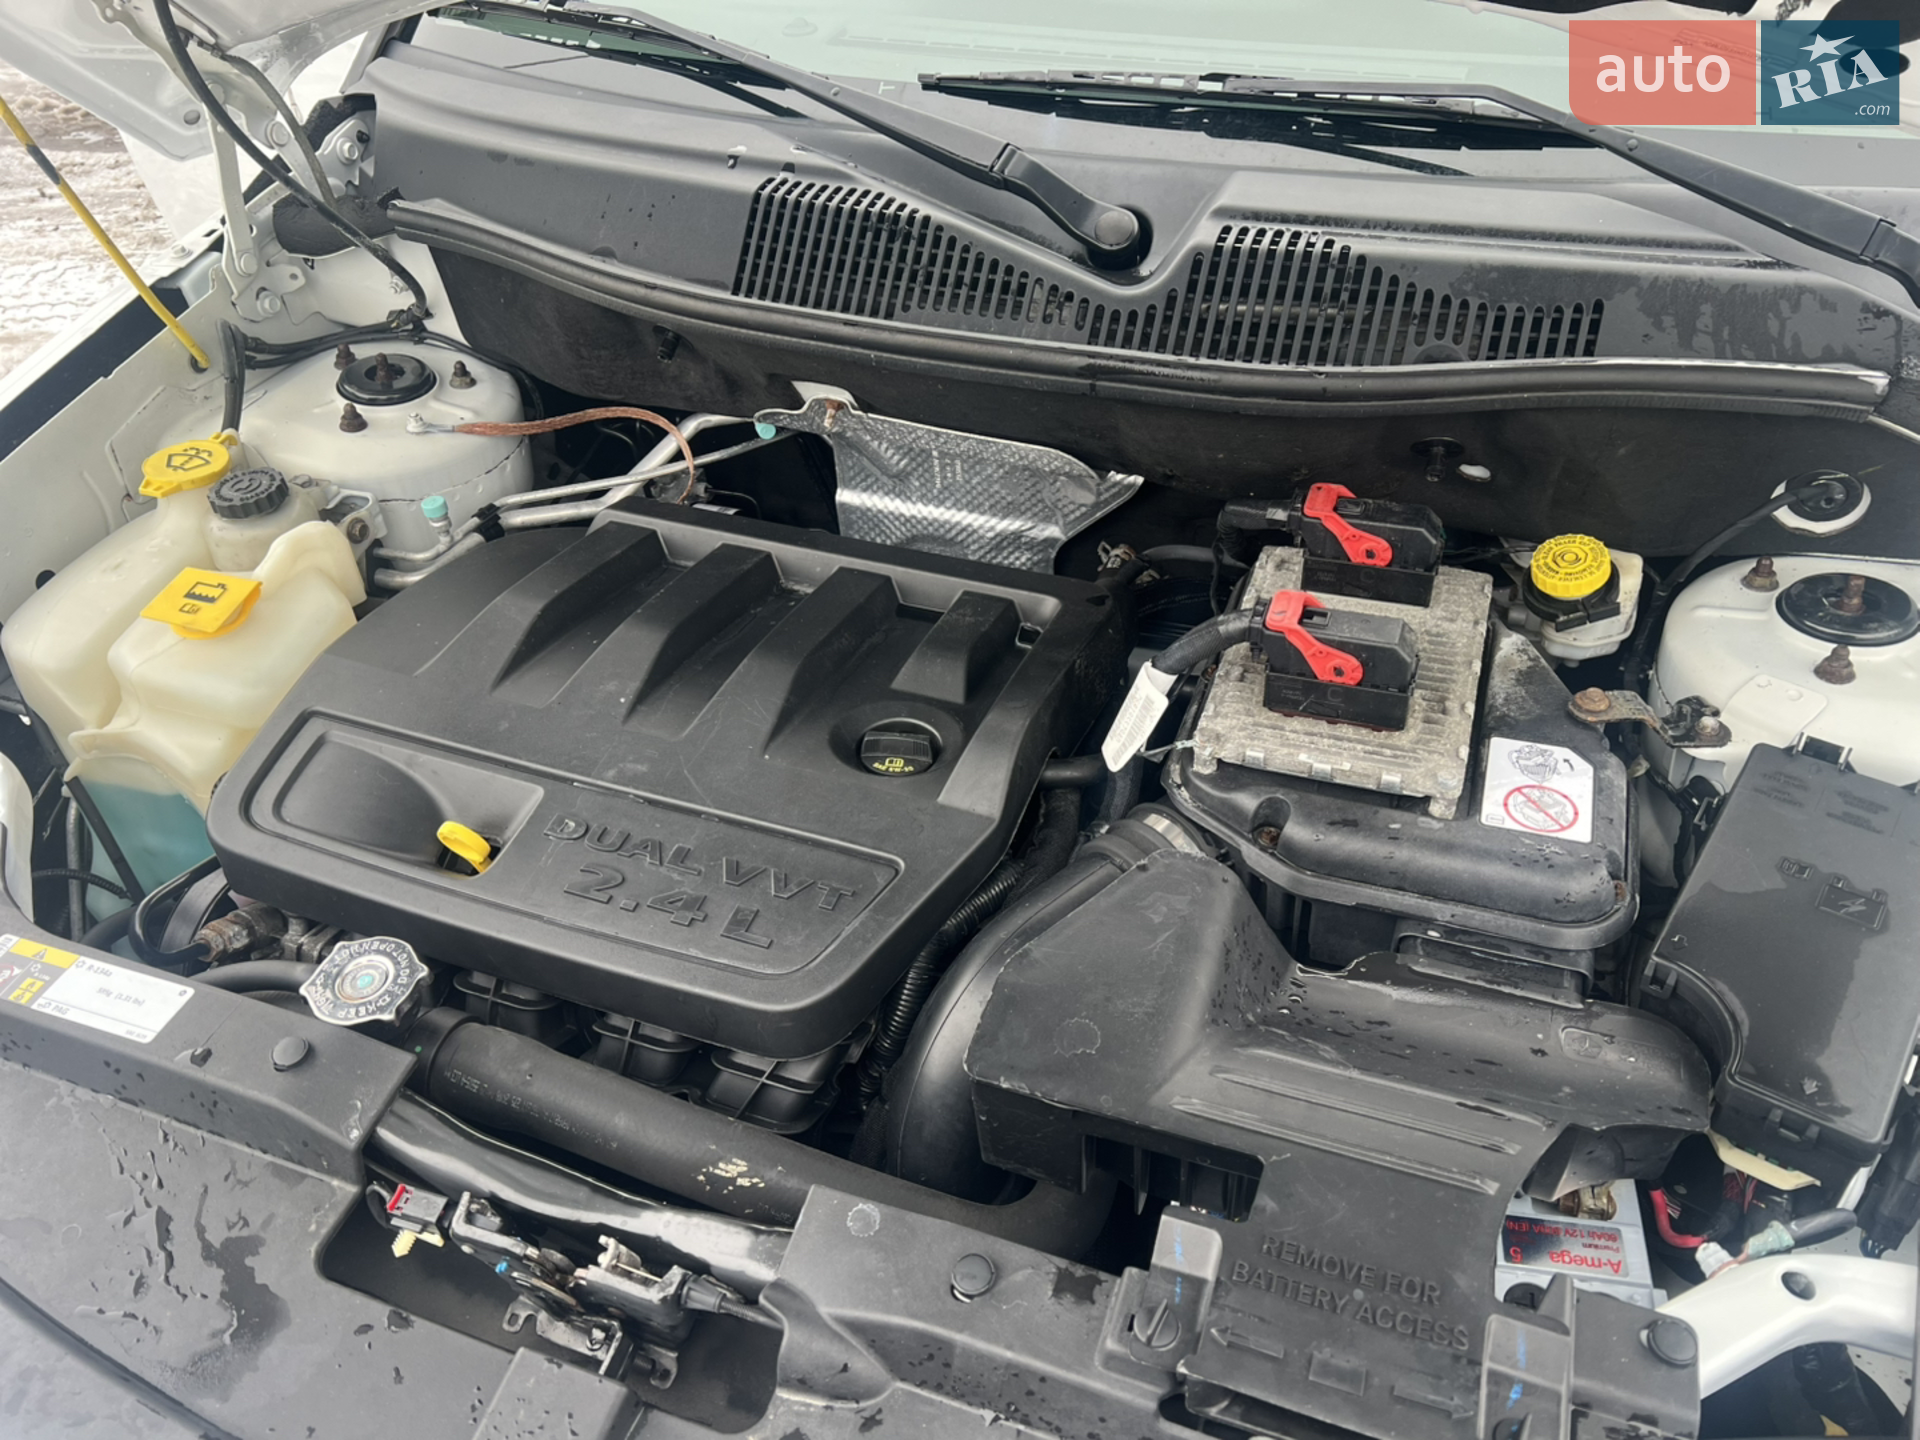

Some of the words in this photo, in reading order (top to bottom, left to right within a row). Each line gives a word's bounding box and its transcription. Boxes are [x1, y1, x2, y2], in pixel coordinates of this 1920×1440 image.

[543, 812, 701, 876] DUAL
[722, 857, 856, 911] VVT
[51, 1006, 70, 1016] PAG
[1506, 1218, 1532, 1233] (EN)
[1564, 1227, 1585, 1239] 12V
[1509, 1246, 1523, 1264] 5
[1581, 1242, 1621, 1254] Premium
[1262, 1235, 1377, 1288] REMOVE
[1384, 1271, 1441, 1306] FOR
[1549, 1249, 1622, 1275] A-mega
[1231, 1260, 1350, 1314] BATTERY
[1355, 1302, 1470, 1351] ACCESS
